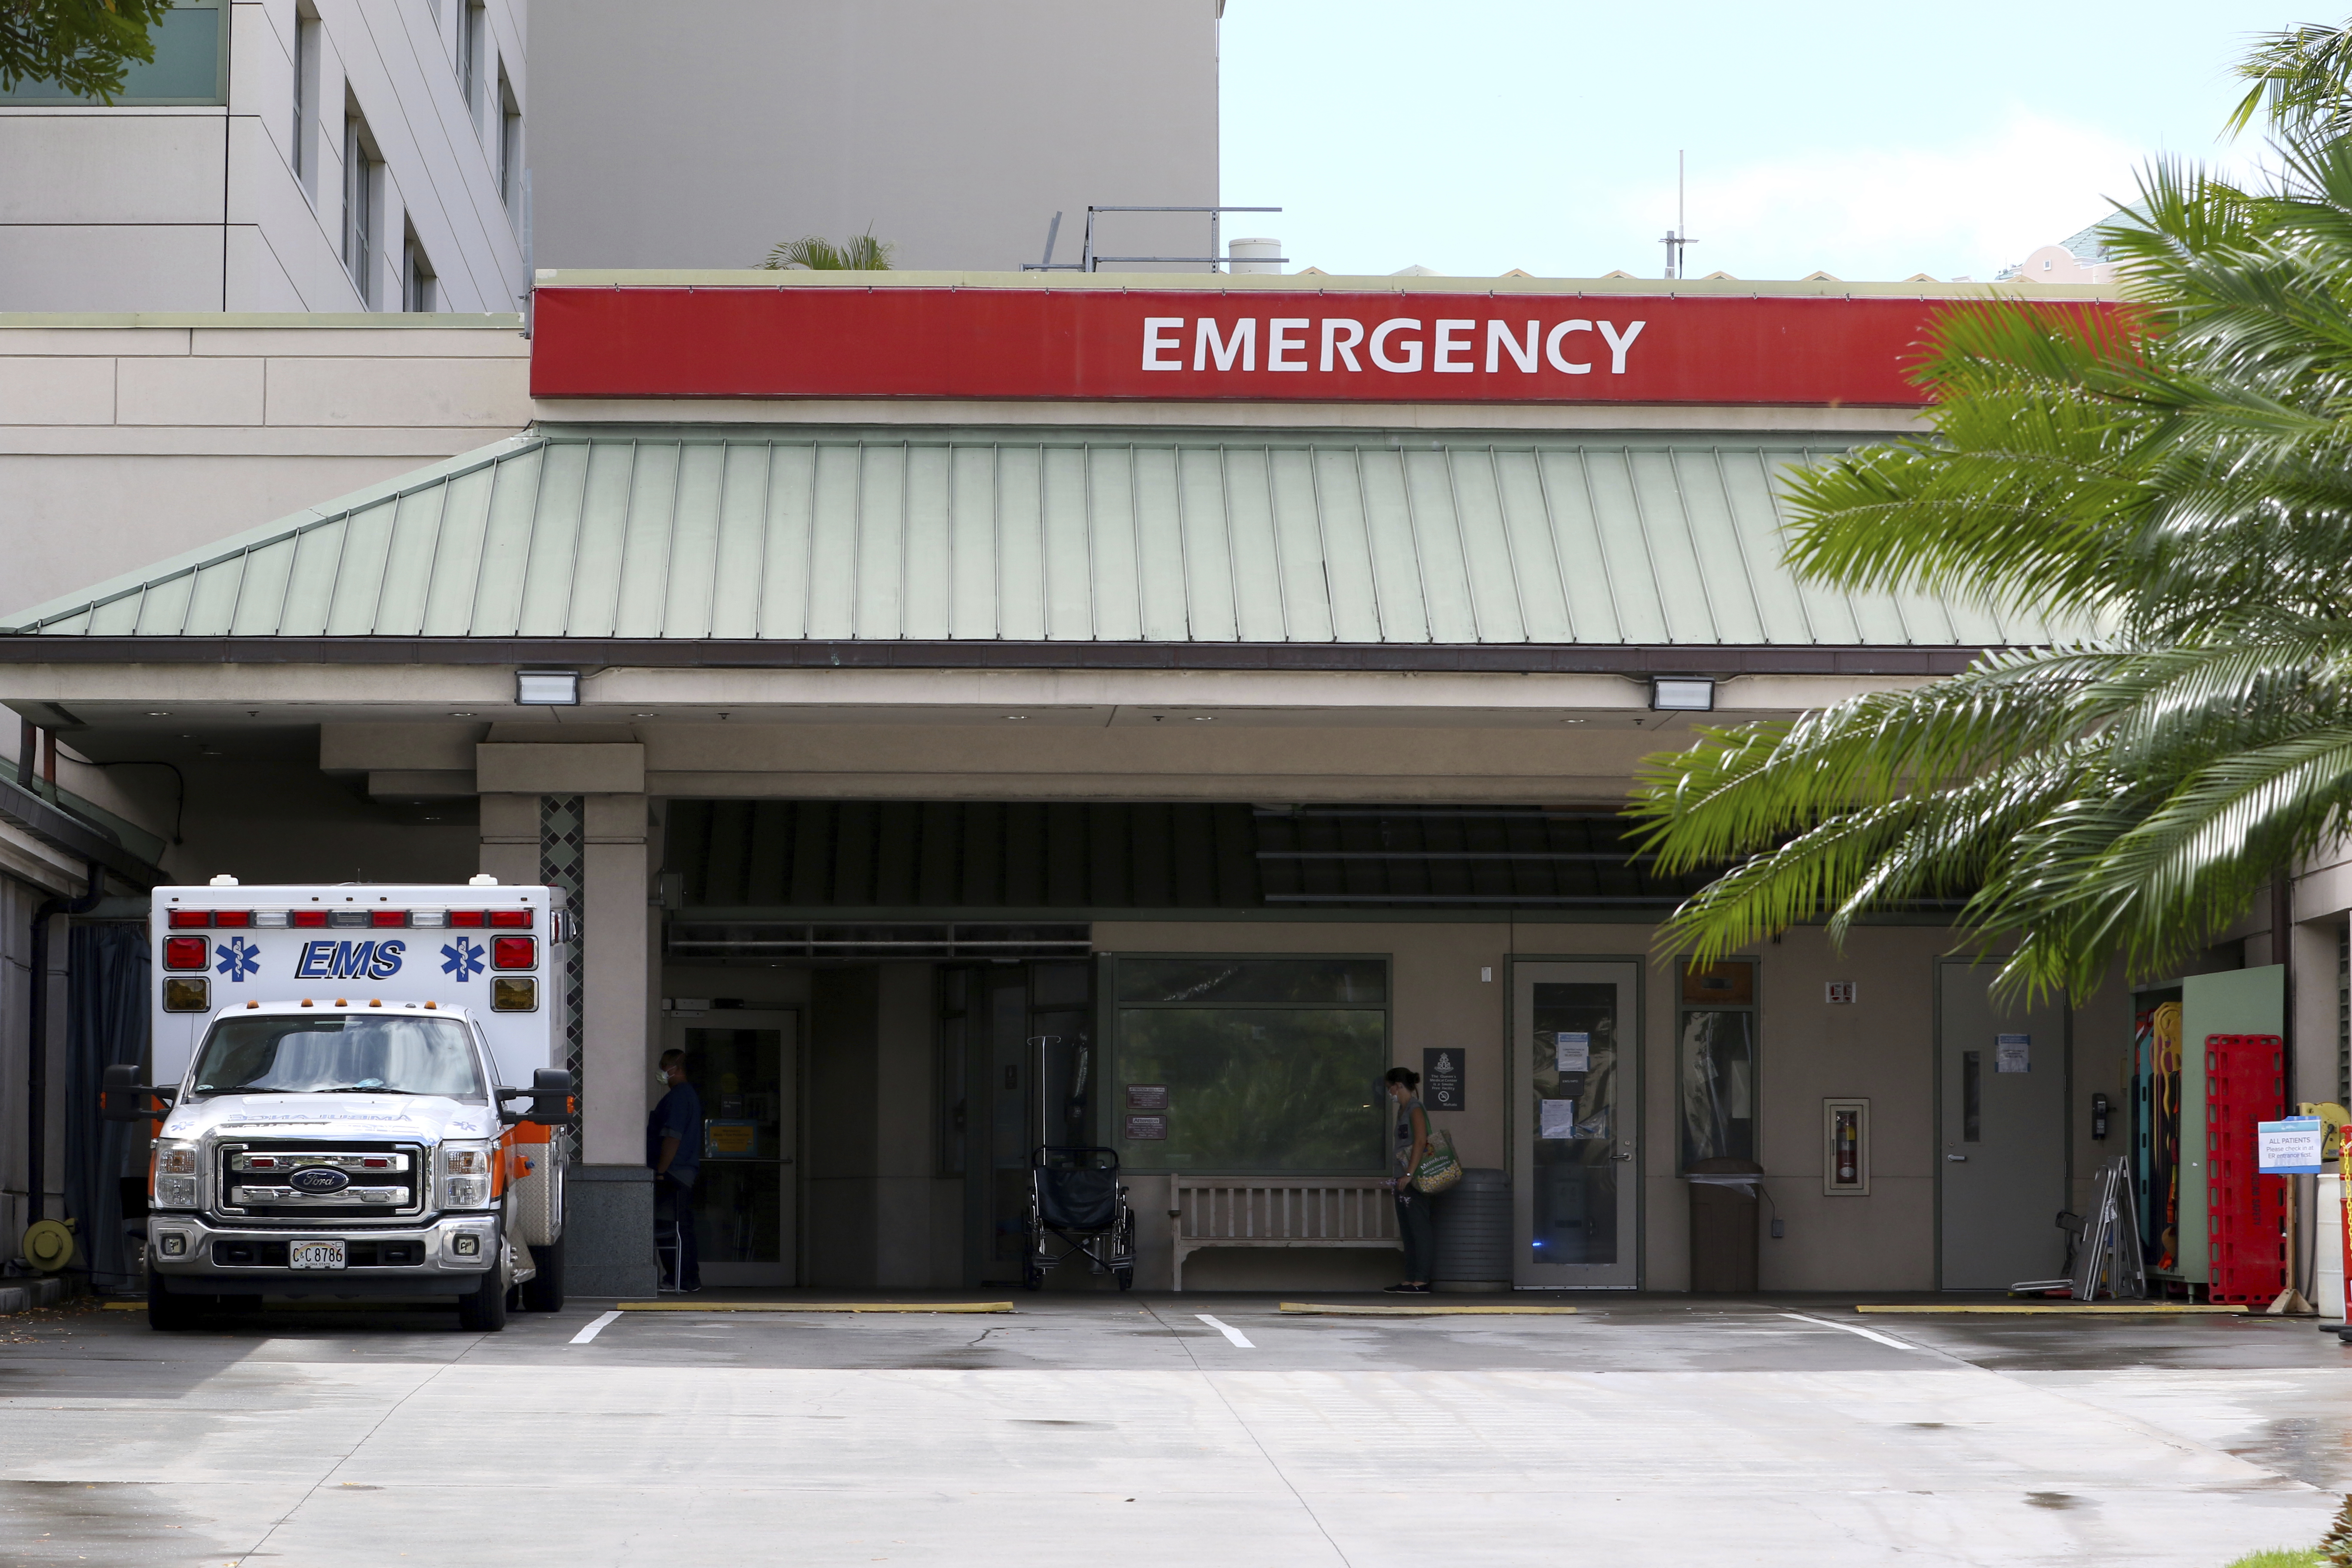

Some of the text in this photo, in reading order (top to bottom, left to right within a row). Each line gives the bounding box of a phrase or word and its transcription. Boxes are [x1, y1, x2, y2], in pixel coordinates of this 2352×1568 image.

[1142, 317, 1647, 374] EMERGENCY
[294, 940, 406, 980] EMS
[2249, 1113, 2257, 1129] CITY
[1434, 1161, 1451, 1169] COMPANY
[303, 1173, 334, 1186] Ford
[2252, 1199, 2261, 1226] SAFETY
[293, 1248, 342, 1262] C&C 8786
